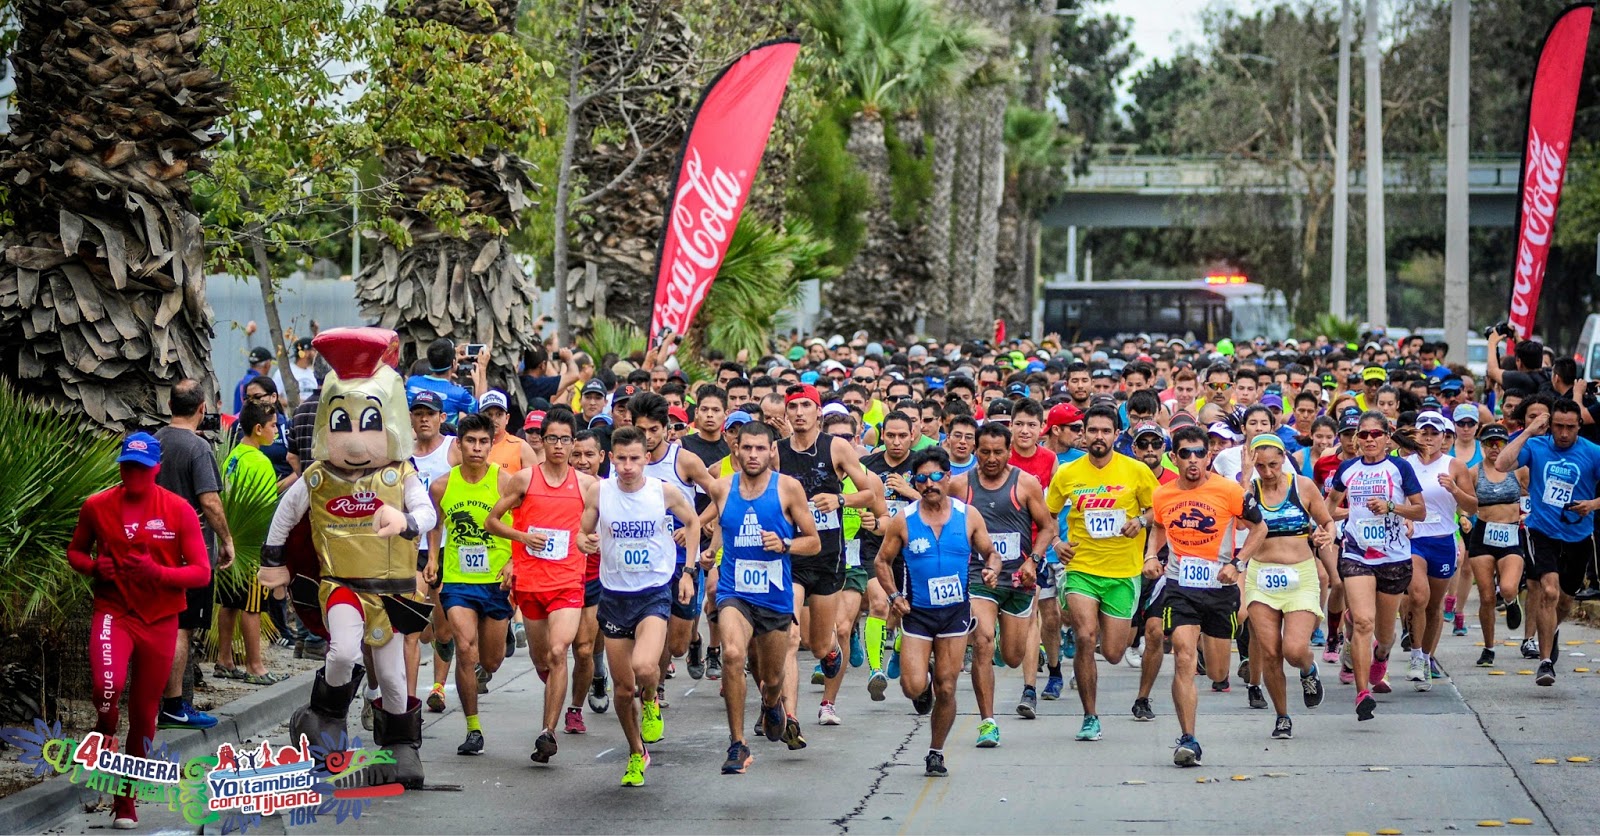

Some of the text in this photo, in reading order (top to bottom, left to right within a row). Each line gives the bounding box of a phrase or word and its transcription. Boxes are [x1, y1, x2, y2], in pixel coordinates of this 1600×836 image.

[1550, 465, 1572, 476] CORRE
[1372, 485, 1386, 494] 10K
[1550, 486, 1571, 502] 725
[331, 499, 376, 514] Roma
[446, 501, 465, 516] CLUB
[611, 520, 656, 533] OBESITY
[739, 524, 763, 537] LUIS
[1089, 517, 1115, 532] 1217
[1363, 526, 1386, 540] 008
[1488, 528, 1509, 543] 1098
[465, 553, 485, 567] 927
[624, 549, 650, 565] 002
[743, 569, 768, 586] 001
[1183, 564, 1210, 581] 1380
[1265, 574, 1288, 588] 399
[933, 582, 962, 600] 1321
[102, 643, 113, 666] una
[103, 671, 116, 699] que
